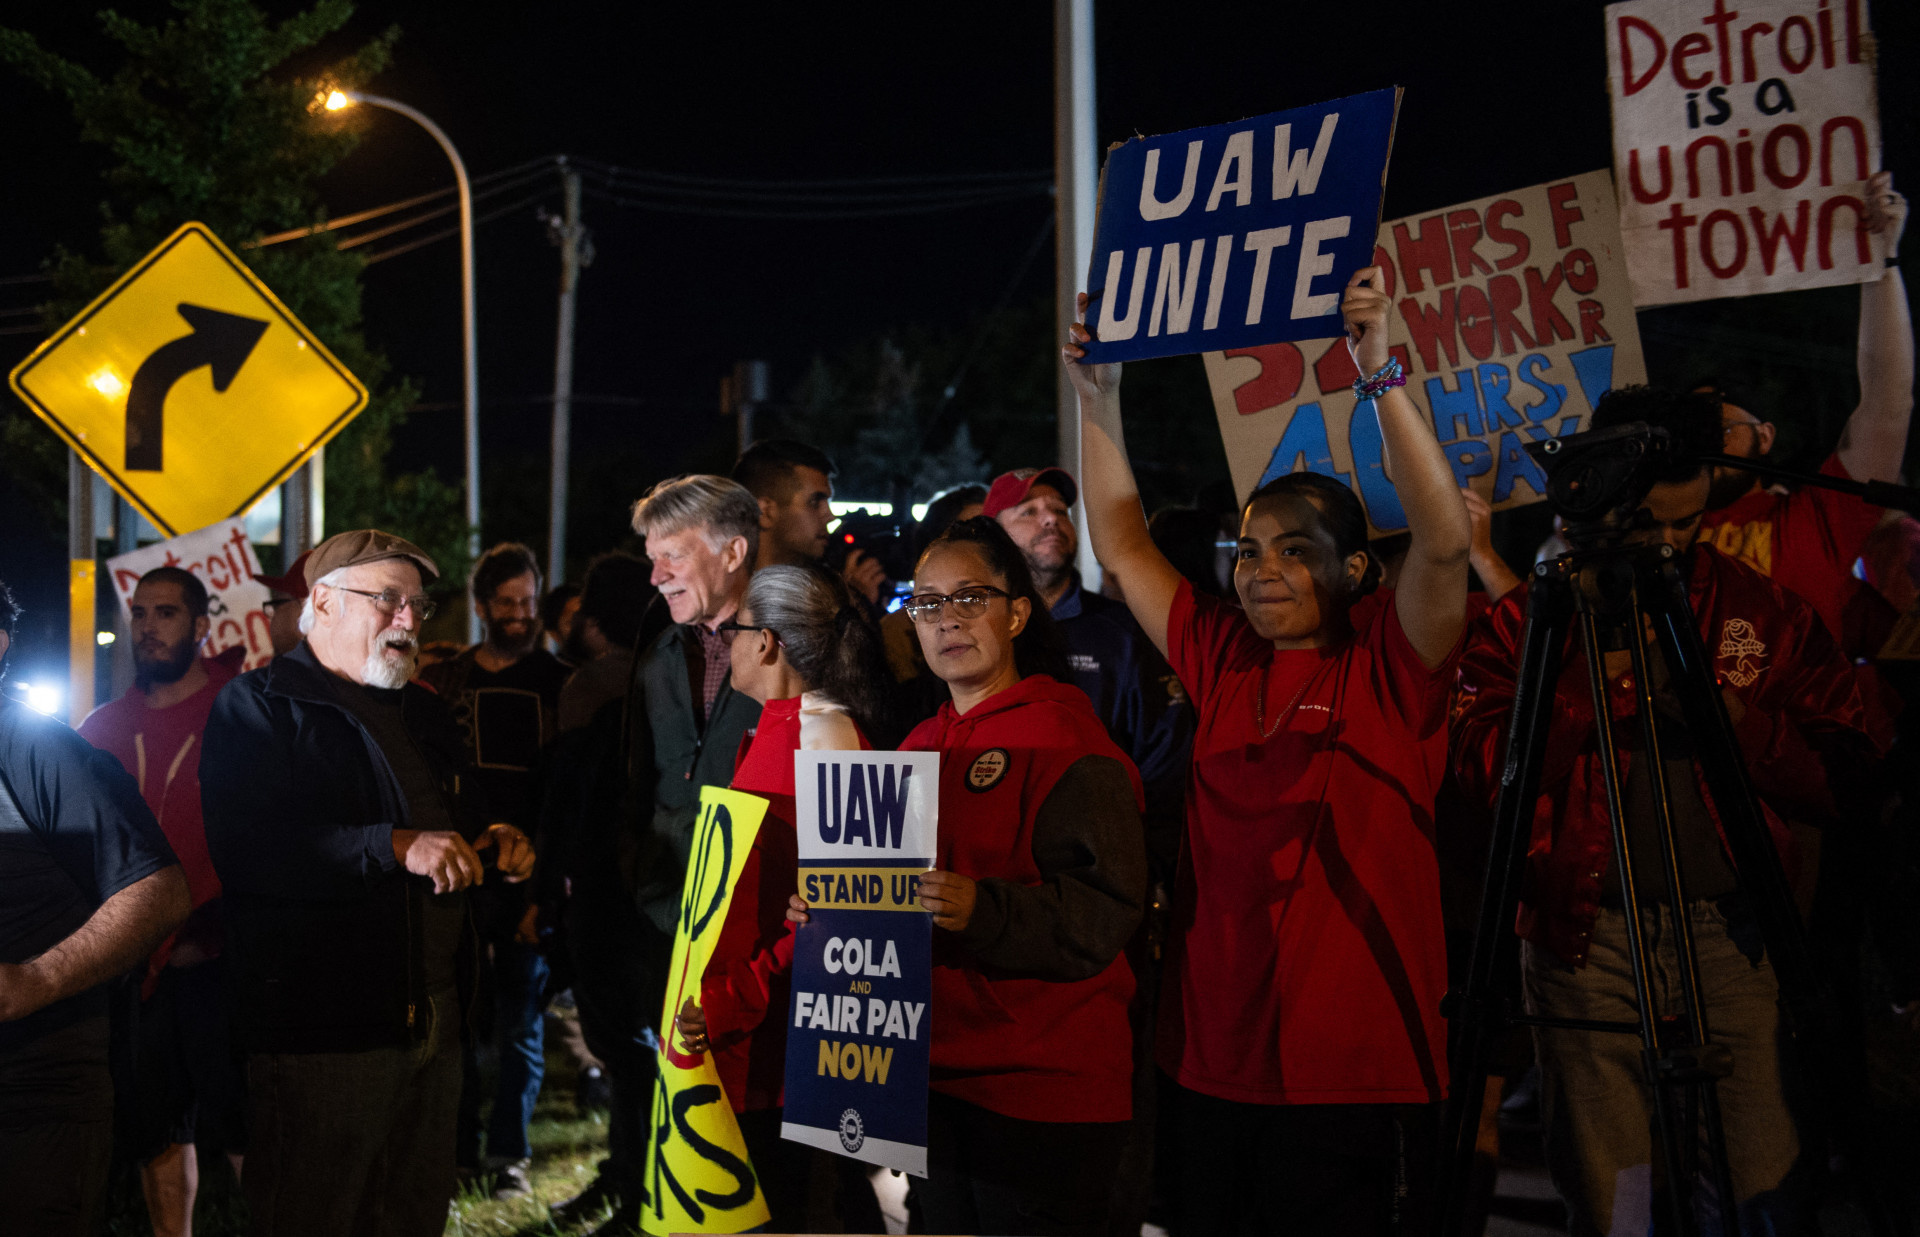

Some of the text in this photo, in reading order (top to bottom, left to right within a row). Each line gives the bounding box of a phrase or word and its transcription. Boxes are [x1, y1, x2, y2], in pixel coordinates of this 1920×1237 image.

[1685, 77, 1796, 128] is a
[1139, 112, 1340, 222] UAW
[1628, 116, 1869, 204] union
[1097, 215, 1351, 342] UNITE
[1392, 198, 1531, 295] HRS
[1658, 195, 1872, 289] town
[1399, 262, 1576, 373] WORK
[817, 763, 914, 850] UAW
[805, 873, 923, 906] STAND UP
[823, 936, 902, 979] COLA
[849, 979, 872, 995] AND
[794, 991, 926, 1041] FAIR PAY
[817, 1039, 895, 1086] NOW
